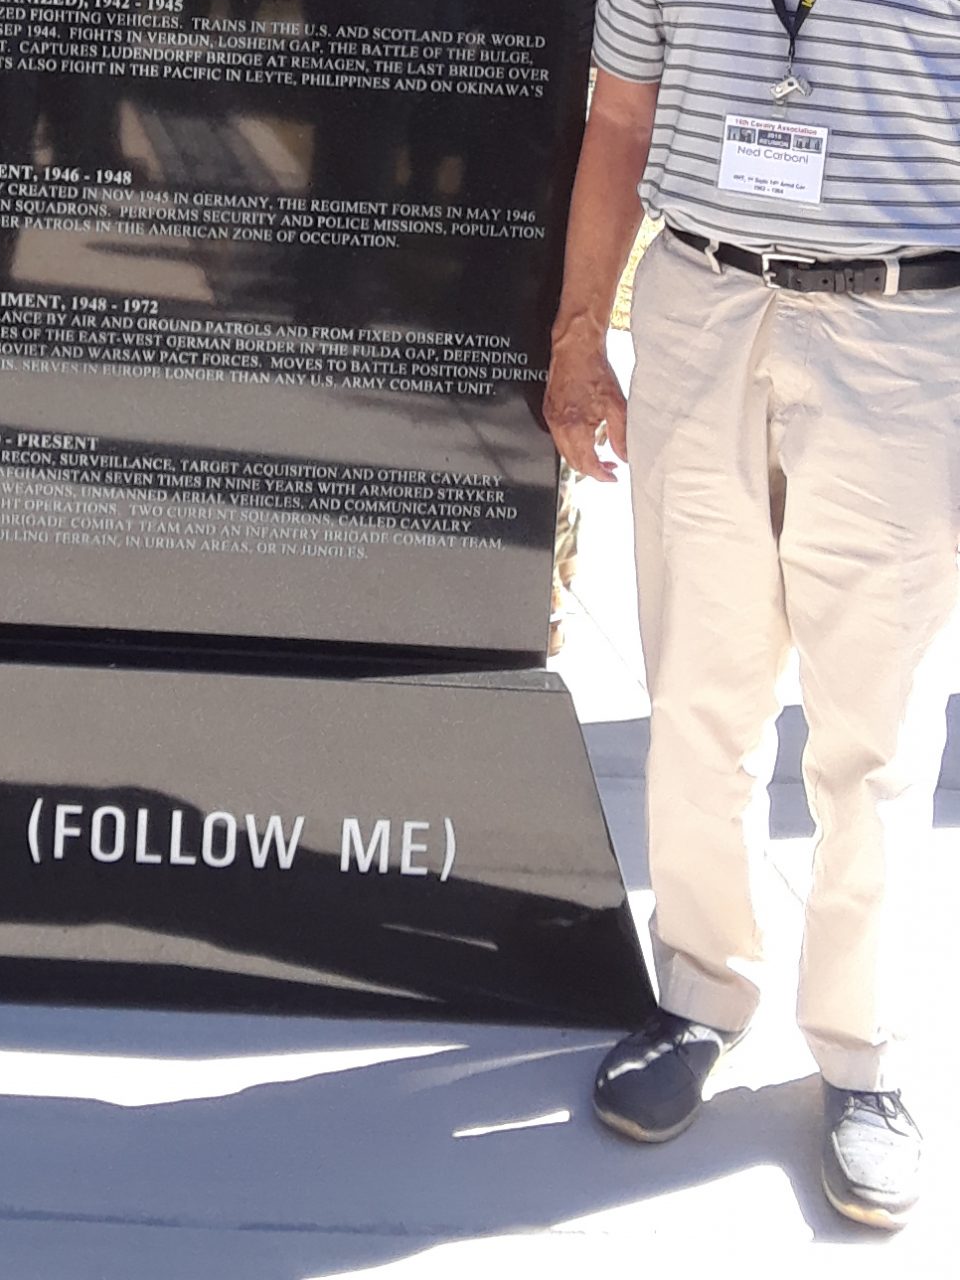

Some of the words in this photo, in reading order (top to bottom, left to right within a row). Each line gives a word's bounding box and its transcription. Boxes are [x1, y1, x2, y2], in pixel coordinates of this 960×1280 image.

[30, 7, 101, 24] FIGHTING
[191, 16, 246, 32] TRAINS
[250, 20, 266, 33] IN
[270, 21, 300, 35] THE
[335, 24, 369, 39] AND
[372, 26, 453, 43] SCOTLAND
[456, 31, 485, 45] FOR
[490, 33, 545, 48] WORLD
[44, 165, 79, 182] 1946
[96, 168, 131, 185] 1948
[24, 215, 90, 232] PATROLS
[95, 219, 111, 233] IN
[114, 220, 144, 235] THE
[148, 222, 228, 239] AMERICAN
[232, 226, 272, 241] ZONE
[276, 229, 296, 243] OF
[71, 295, 106, 312] 1948
[124, 298, 158, 314] 1972
[46, 312, 66, 326] BY
[70, 313, 96, 327] AIR
[100, 314, 133, 329] AND
[136, 316, 202, 333] GROUND
[205, 320, 271, 336] PATROLS
[275, 323, 308, 338] AND
[311, 325, 354, 340] FROM
[357, 328, 402, 343] FIXED
[404, 330, 510, 348] OBSERVATION
[17, 432, 98, 451] PRESENT
[180, 458, 239, 474] TARGET
[242, 461, 338, 479] ACQUISITION
[340, 466, 374, 481] AND
[377, 468, 426, 484] OTHER
[430, 471, 502, 487] CAVALRY
[27, 797, 305, 870] (FOLLOW
[340, 817, 456, 881] ME)
